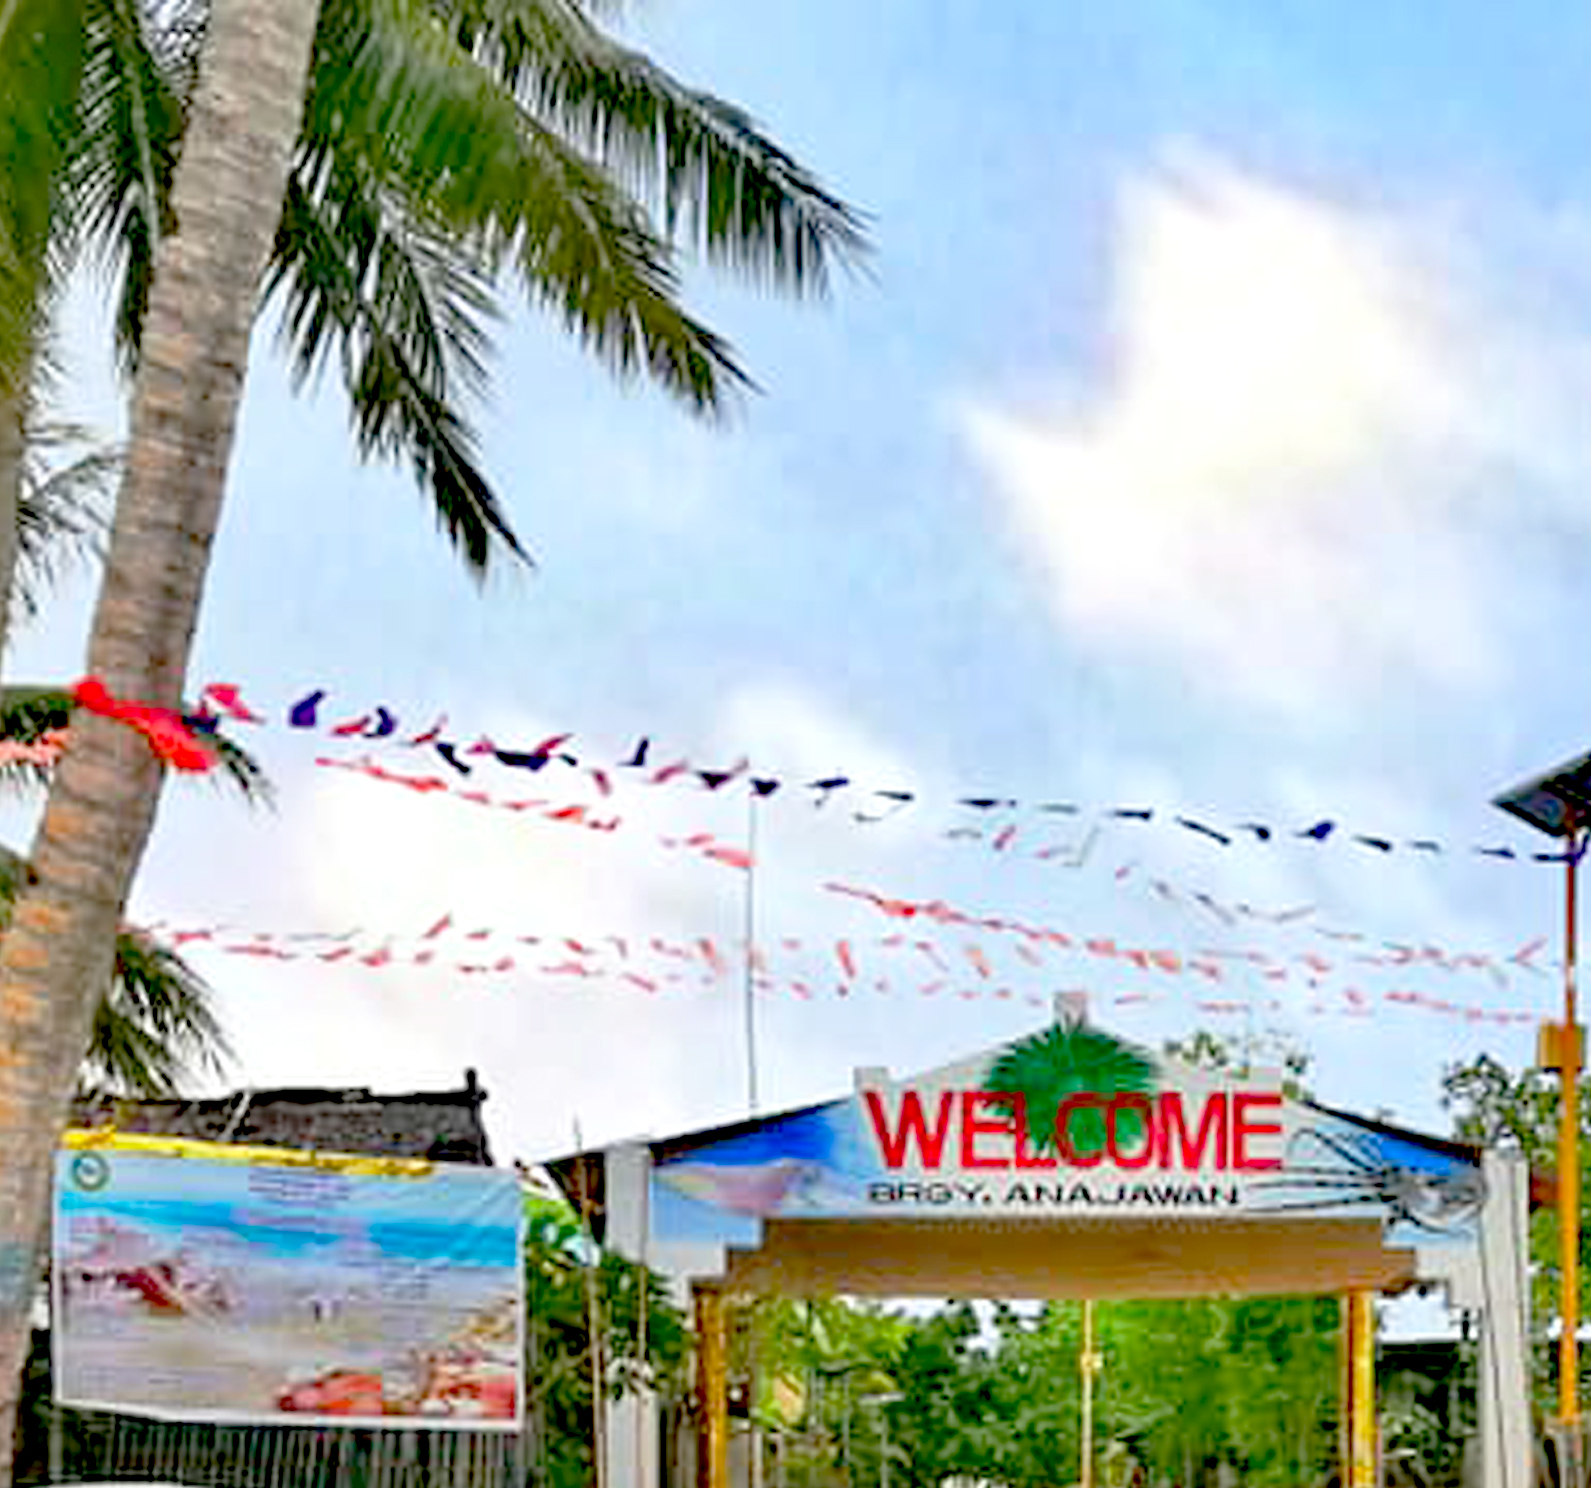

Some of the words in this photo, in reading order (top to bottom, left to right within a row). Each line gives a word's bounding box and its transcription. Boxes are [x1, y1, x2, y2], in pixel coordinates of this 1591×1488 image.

[862, 1091, 1282, 1170] WELCOME
[867, 1182, 991, 1206] BRGY.
[1006, 1182, 1240, 1207] ANAJAWAN
